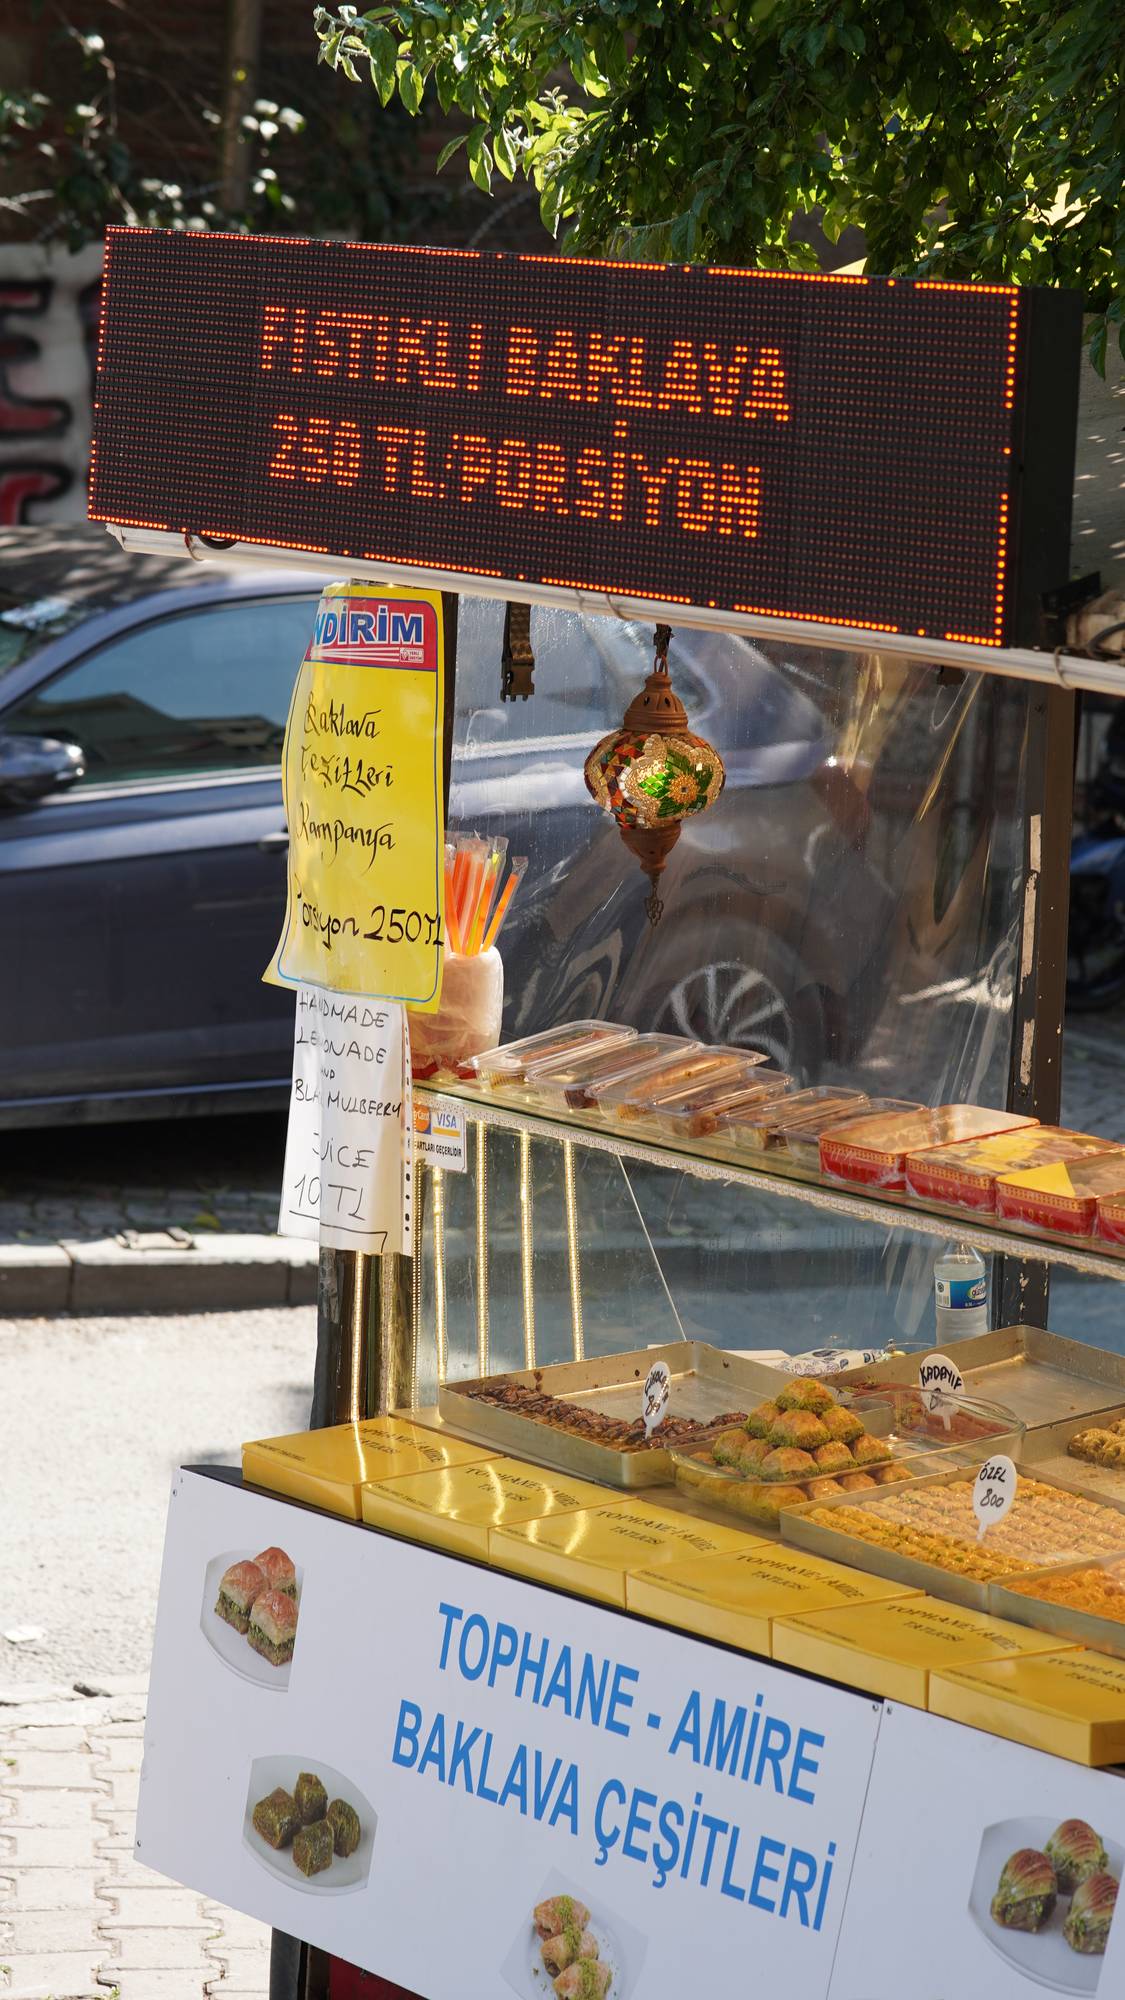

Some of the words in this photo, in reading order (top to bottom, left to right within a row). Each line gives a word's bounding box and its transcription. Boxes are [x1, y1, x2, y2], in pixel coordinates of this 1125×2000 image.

[260, 306, 484, 392] FISTIKLI
[504, 327, 791, 422] BAKLAVA
[268, 413, 362, 488] 250
[296, 1026, 387, 1064] LEONADE
[328, 1091, 402, 1118] MULBERRY
[437, 1112, 457, 1129] VISA
[415, 1140, 435, 1153] ARTLARI
[328, 1183, 366, 1221] TL
[980, 1462, 1007, 1483] ÖZEL
[980, 1488, 1005, 1508] 800
[438, 1602, 640, 1738] TOPHANE
[667, 1690, 826, 1806] AMİRE
[391, 1699, 579, 1837] BAKLAVA
[594, 1778, 838, 1933] ÇEŞİTLERİ
